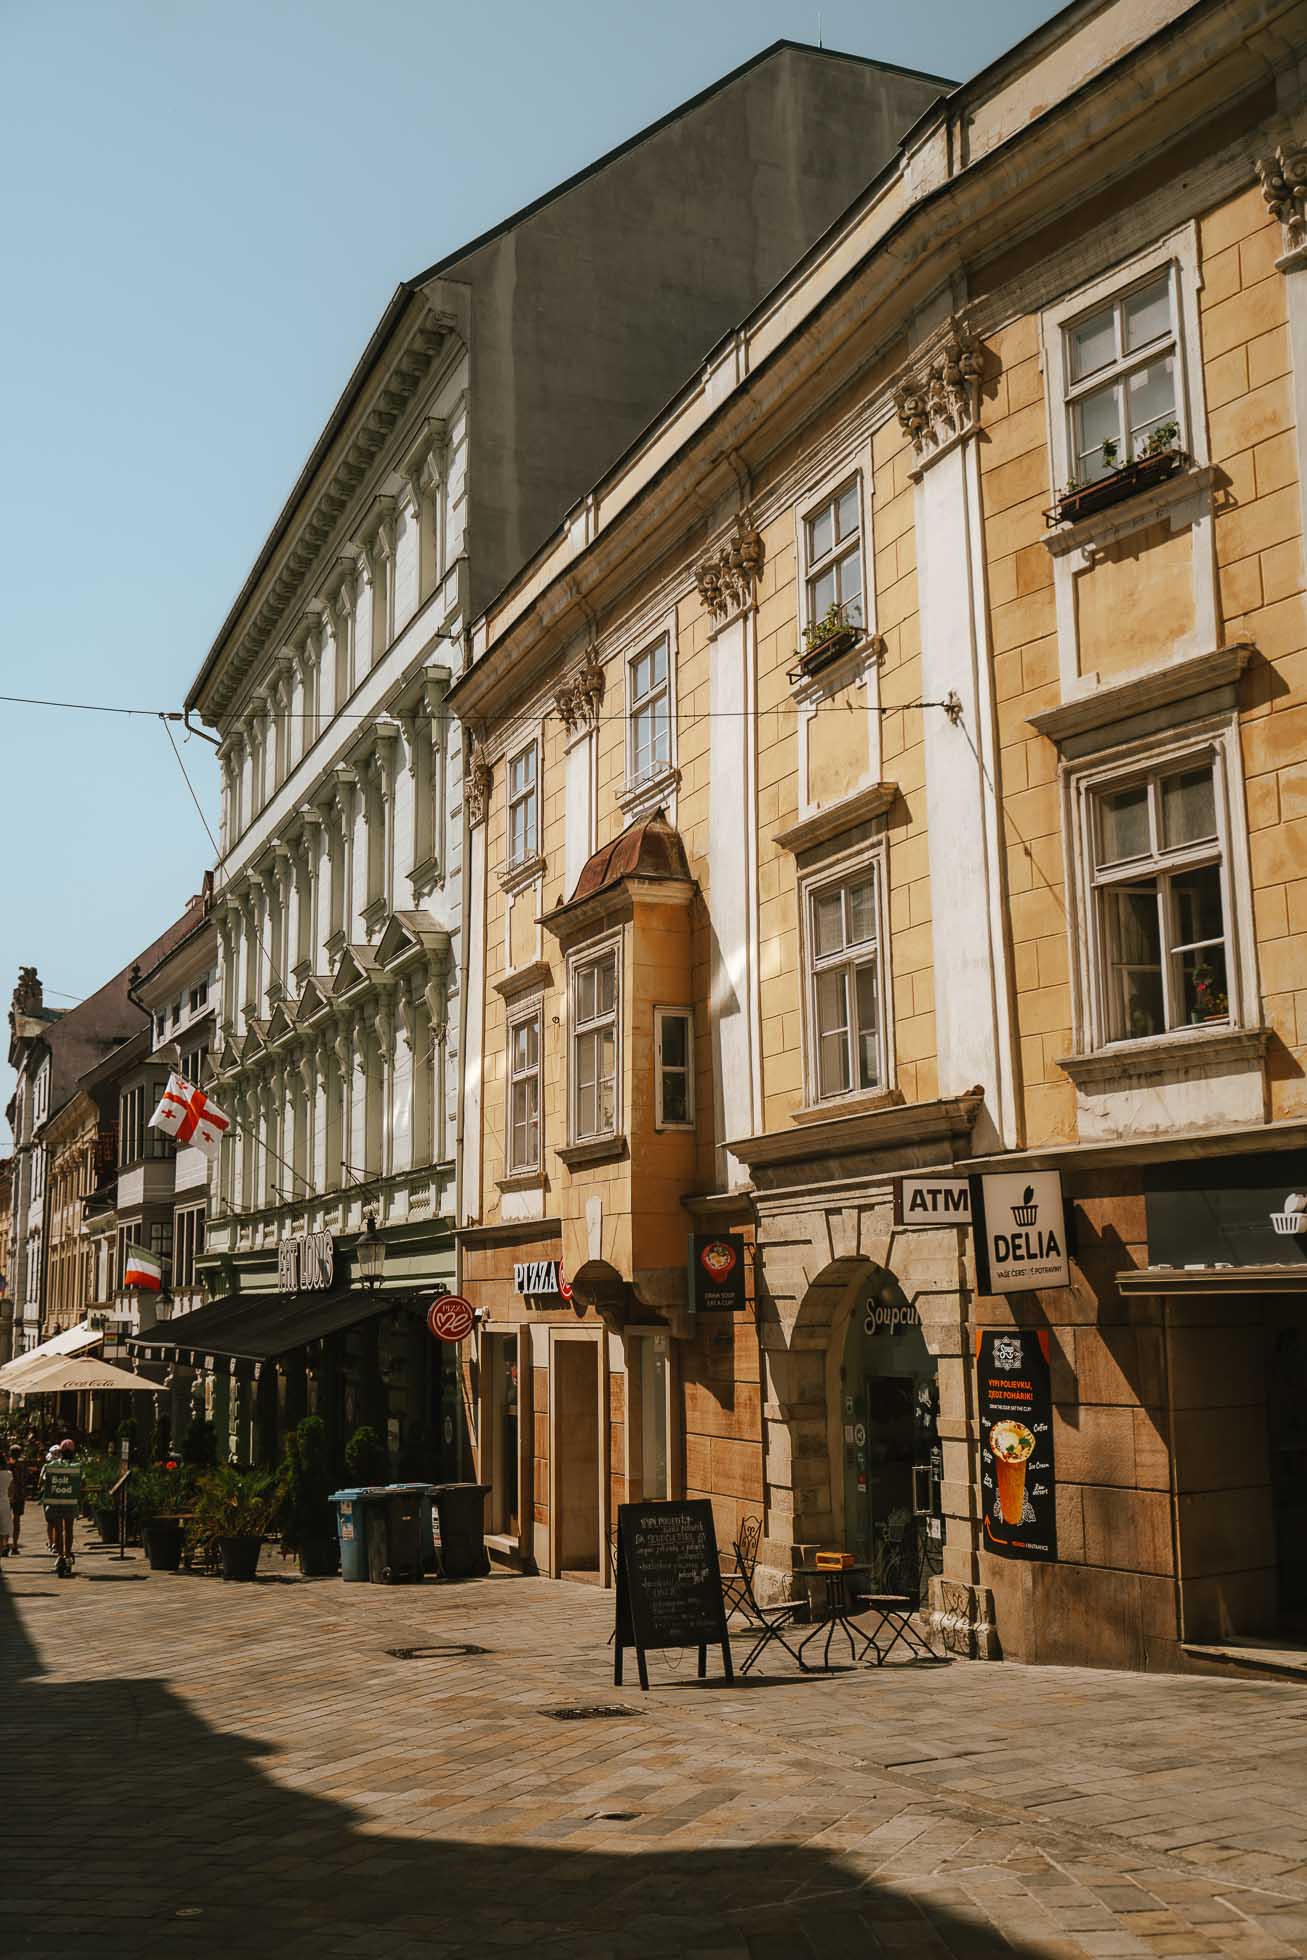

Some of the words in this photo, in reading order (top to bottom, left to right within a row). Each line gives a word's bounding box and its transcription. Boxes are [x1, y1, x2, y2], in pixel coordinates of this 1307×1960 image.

[909, 1189, 968, 1212] ATM
[994, 1230, 1061, 1263] DELIA
[513, 1260, 559, 1295] PIZZA
[51, 1485, 73, 1494] Food
